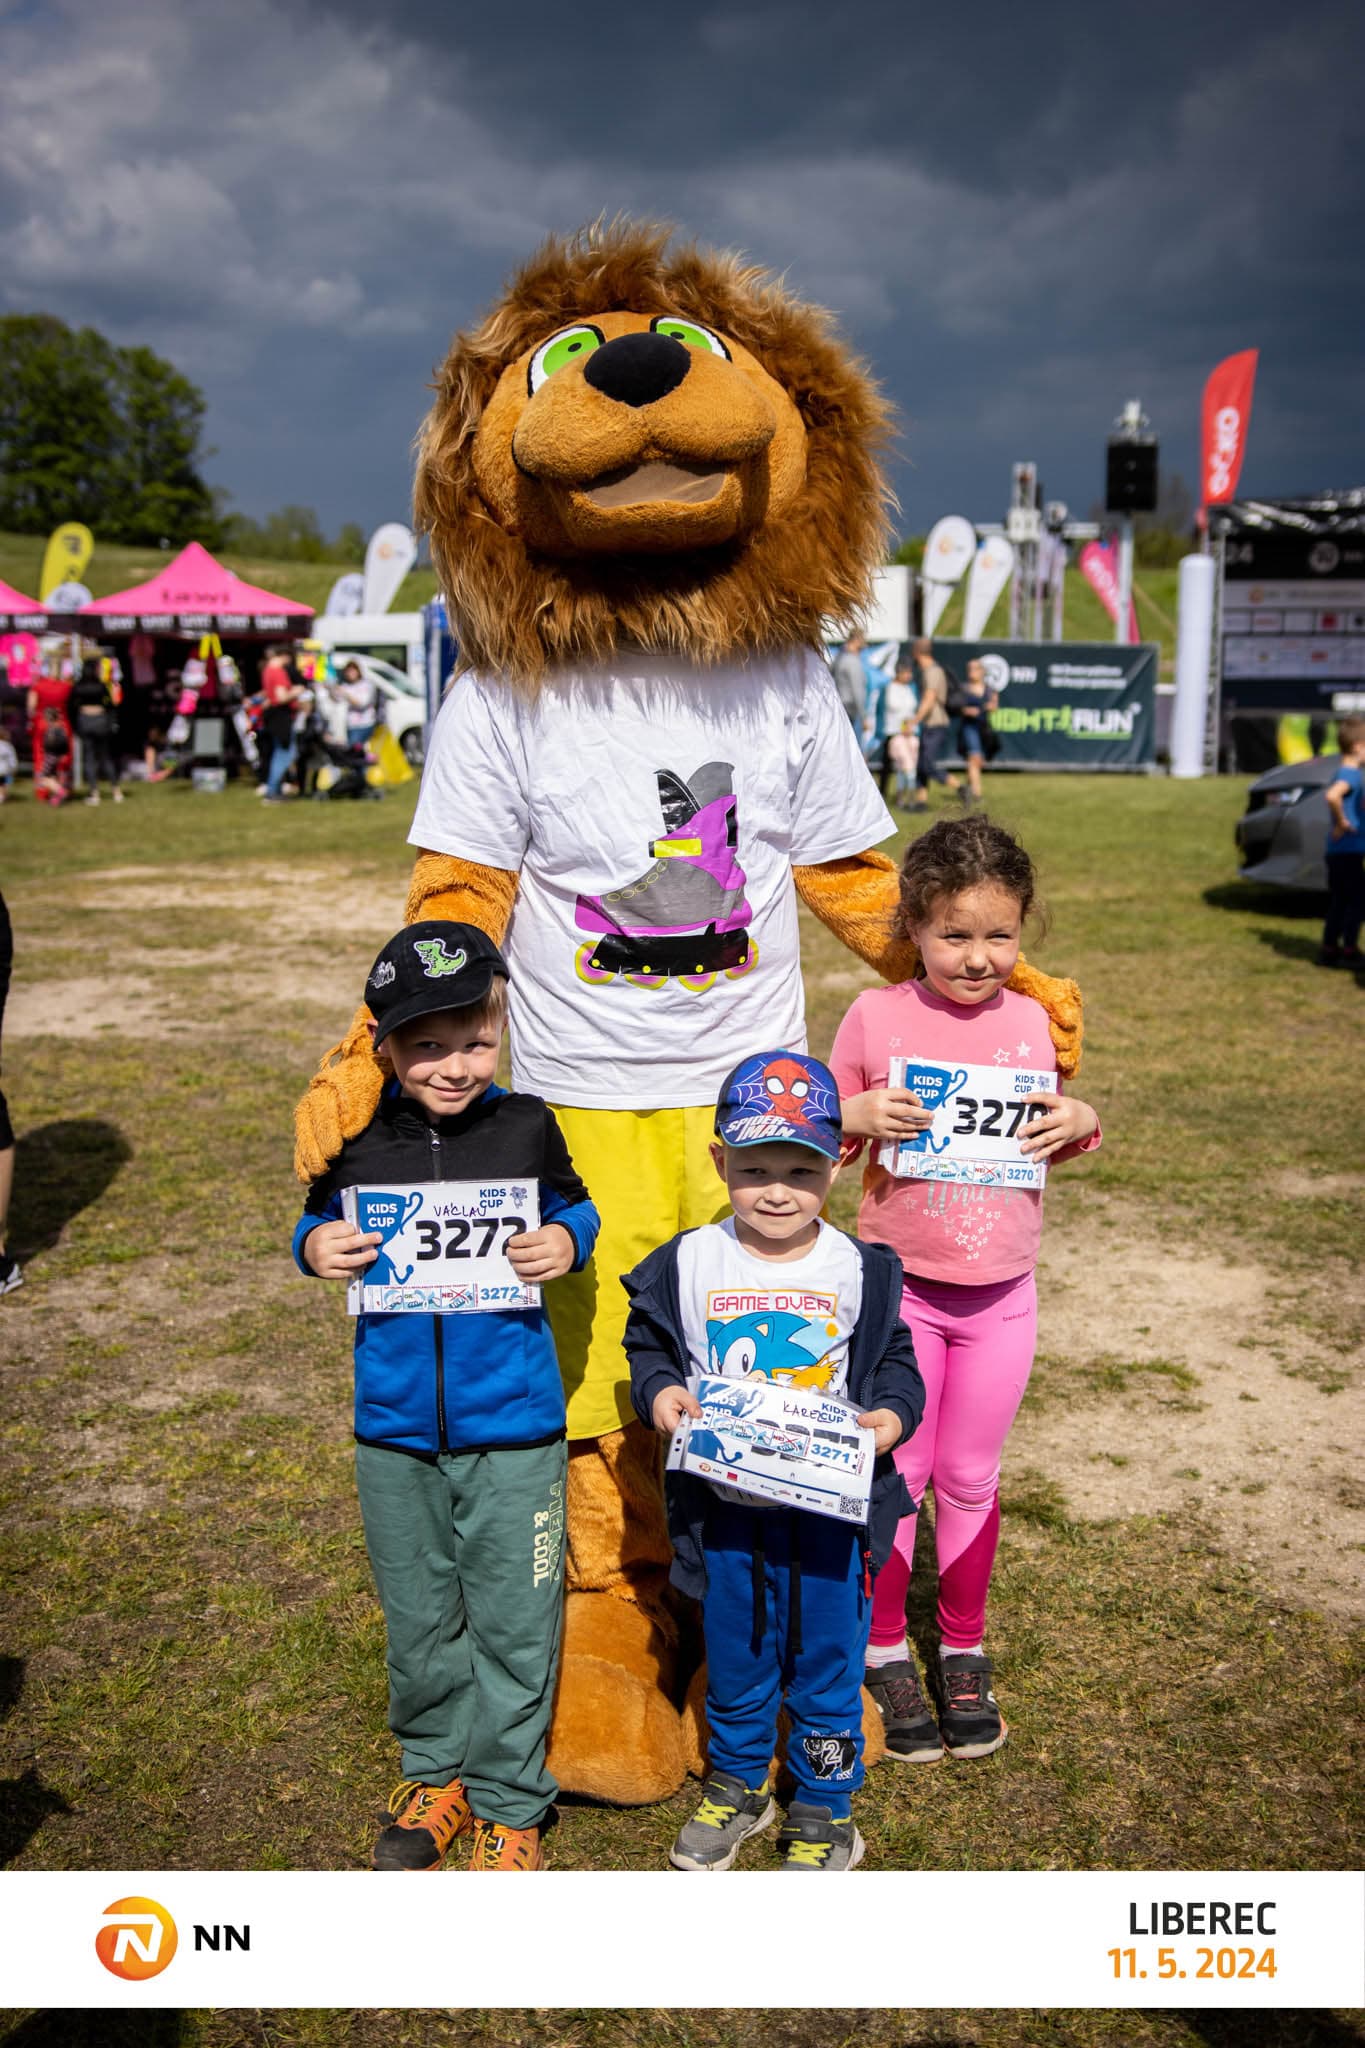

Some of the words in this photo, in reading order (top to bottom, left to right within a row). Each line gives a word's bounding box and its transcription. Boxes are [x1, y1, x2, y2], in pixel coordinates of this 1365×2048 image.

[913, 1075, 943, 1087] KIDS
[1015, 1075, 1035, 1084] KIDS
[914, 1088, 939, 1099] CUP
[1014, 1085, 1032, 1093] CUP
[1007, 1169, 1034, 1180] 3270
[480, 1189, 506, 1198] KIDS
[367, 1203, 398, 1214] KIDS
[480, 1200, 503, 1208] CUP
[368, 1217, 395, 1227] CUP
[481, 1286, 520, 1300] 3272
[713, 1296, 770, 1312] GAME
[775, 1296, 832, 1312] OVER
[821, 1402, 847, 1417] KIDS
[819, 1412, 844, 1424] CUP
[811, 1444, 850, 1464] 3271
[534, 1510, 549, 1528] &
[534, 1531, 549, 1588] COOL
[824, 1739, 842, 1765] 2
